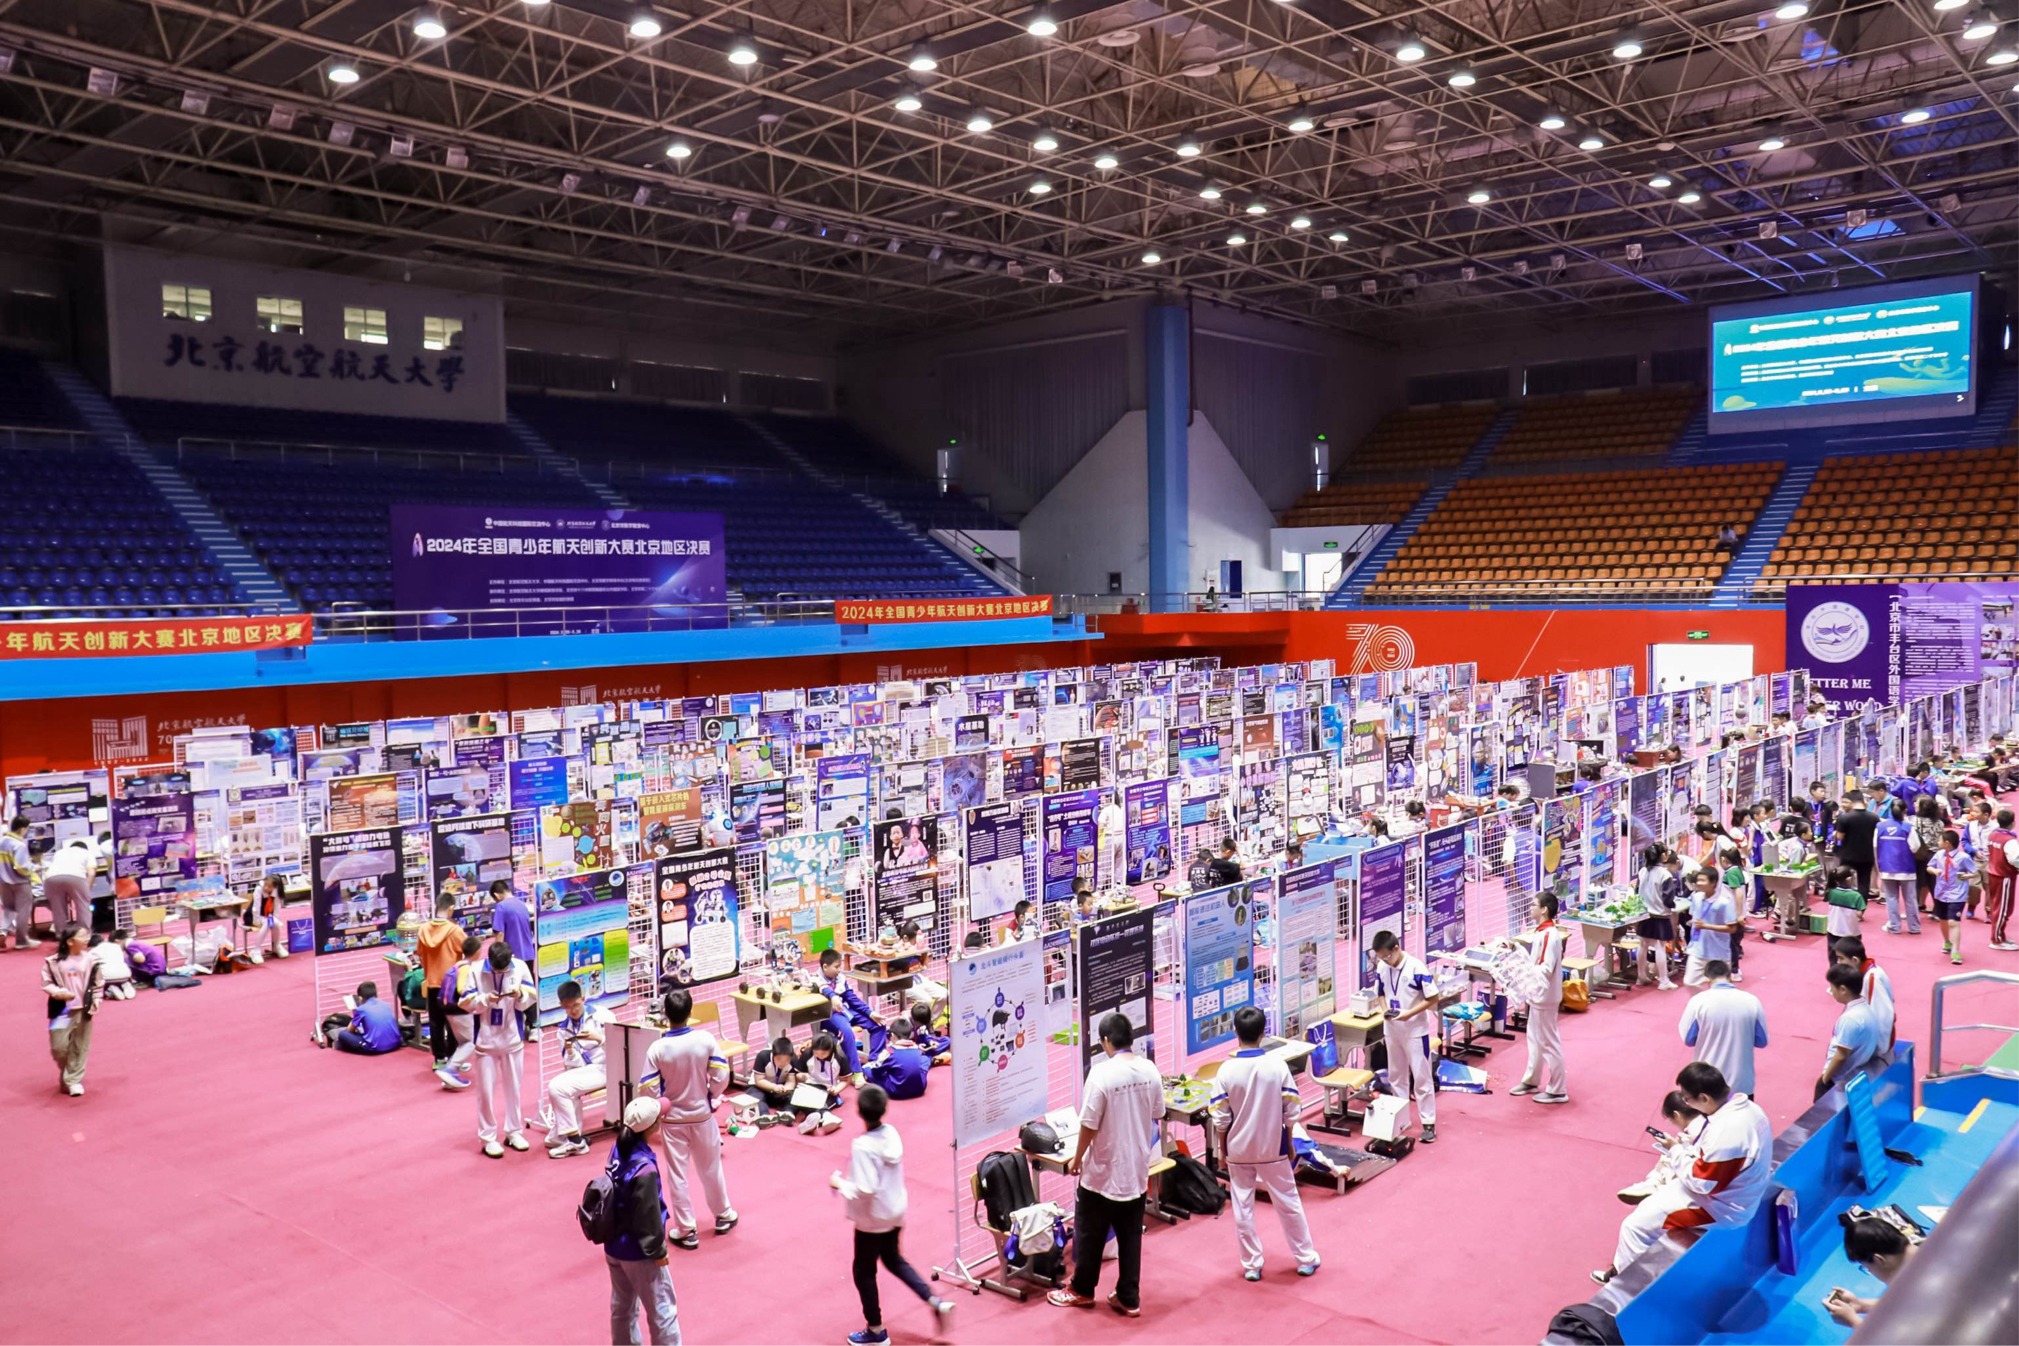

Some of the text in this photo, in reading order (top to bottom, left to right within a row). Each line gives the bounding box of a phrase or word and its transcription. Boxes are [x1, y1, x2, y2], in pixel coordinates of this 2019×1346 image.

[426, 537, 711, 556] 2024年全国青少年航天创新大赛北京地区决赛
[841, 599, 1050, 620] 2024年全国青少年航天创新大赛北京地区决赛
[0, 622, 303, 652] 年航天创新大赛北京地区决赛
[1346, 623, 1415, 675] 70
[1808, 678, 1872, 689] ETTER ME
